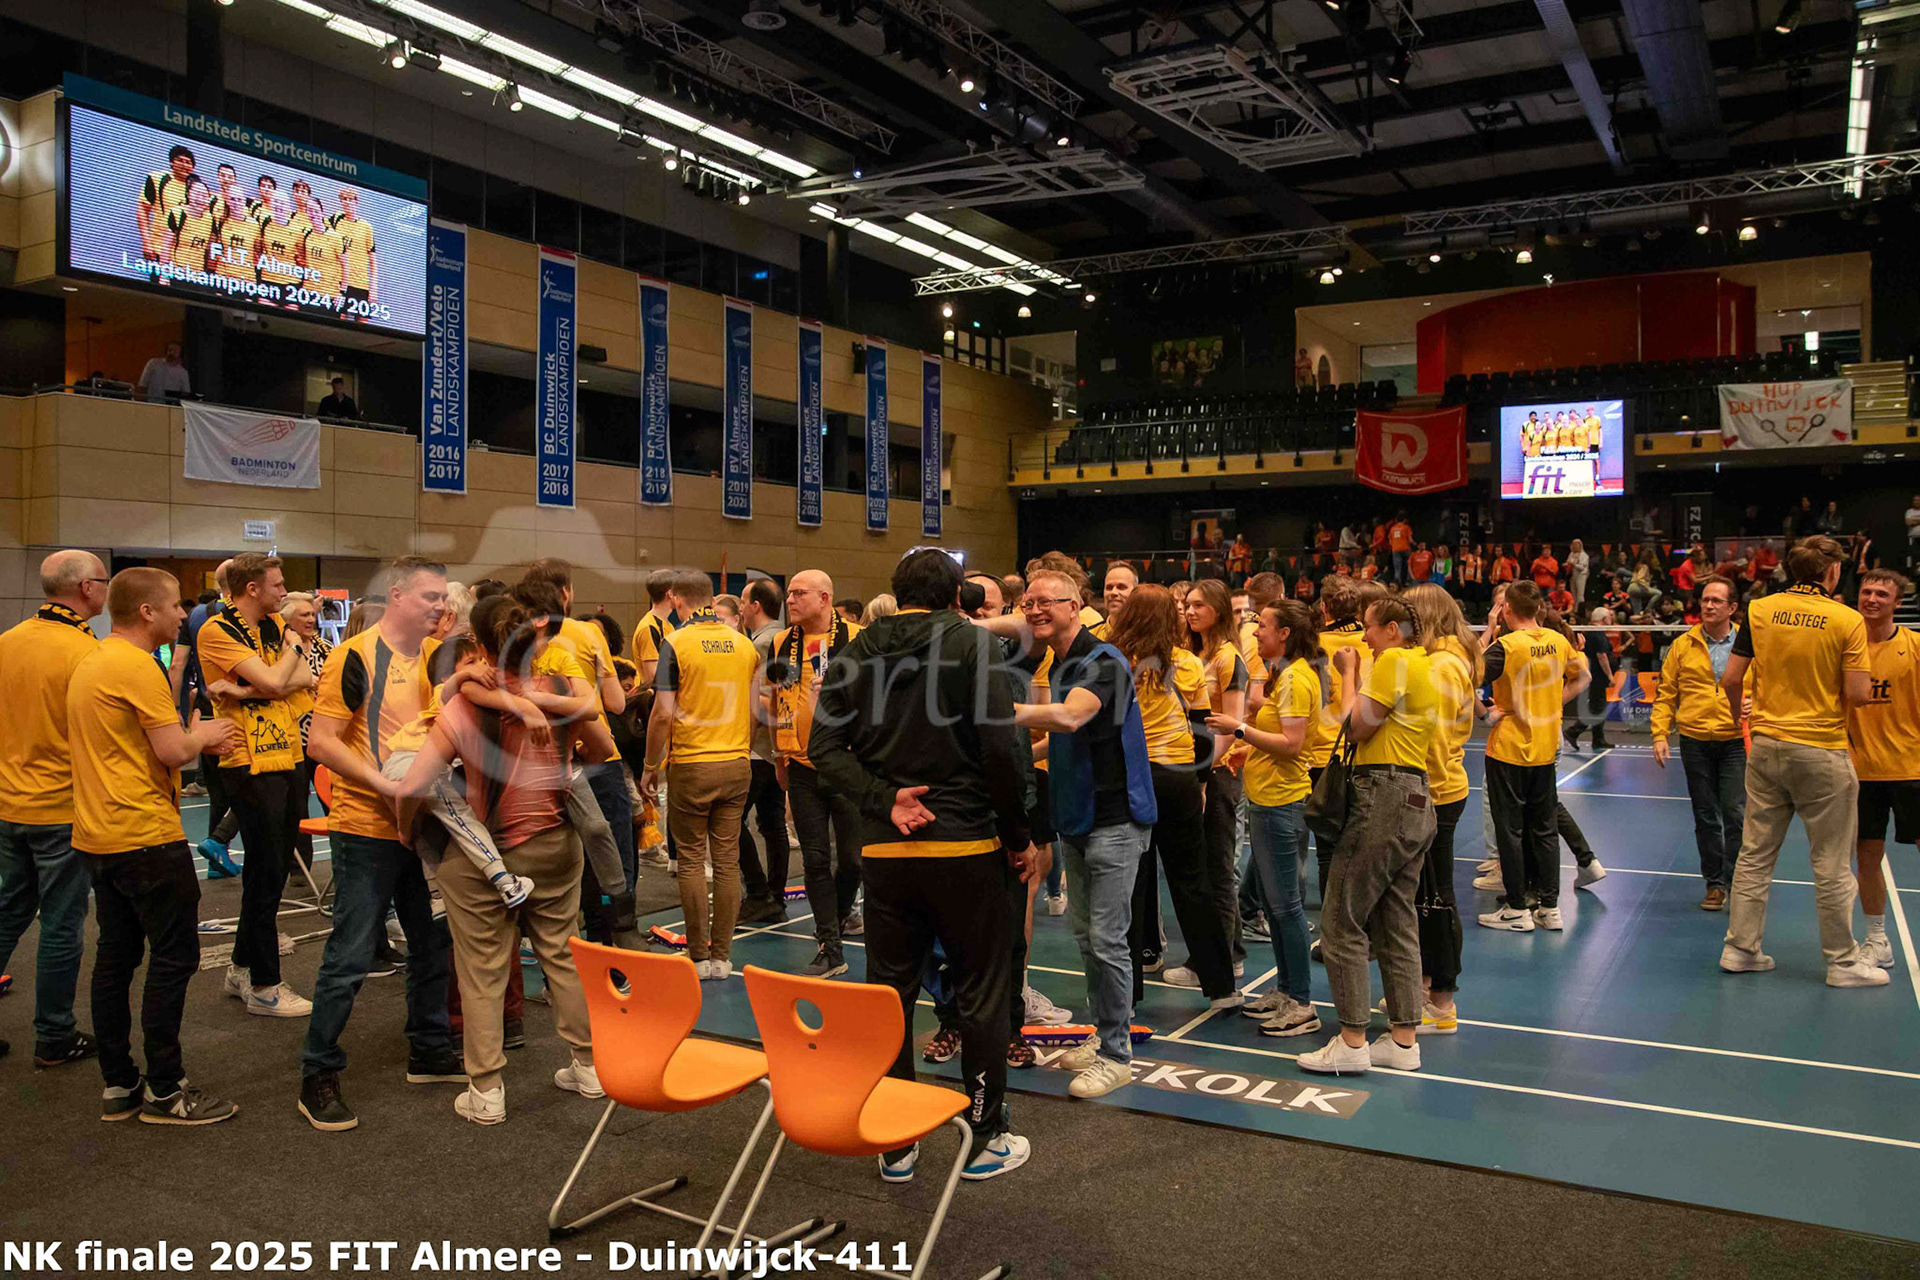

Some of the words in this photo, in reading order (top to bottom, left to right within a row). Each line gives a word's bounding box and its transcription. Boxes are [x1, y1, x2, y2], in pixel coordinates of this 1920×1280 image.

[163, 104, 251, 145] Landstede
[254, 132, 358, 176] Sportcentrum
[256, 255, 322, 283] Almere
[121, 250, 281, 301] Landskampioen
[285, 285, 333, 309] 2024
[346, 298, 391, 321] 2025
[430, 284, 443, 399] Zundert/Velo
[447, 286, 461, 437] LANDSKAMPIOEN
[543, 351, 556, 429] Duinwijck
[558, 317, 570, 457] LANDSKAMPIOEN
[1763, 381, 1803, 399] HUP
[655, 344, 666, 460] LANDSKAMPIOEN
[430, 407, 443, 436] Van
[741, 364, 749, 475] LANDSKAMPIOEN
[812, 381, 820, 485] LANDSKAMPIOEN
[428, 443, 461, 461] 2016
[544, 432, 556, 455] BC
[231, 456, 296, 471] BADMINTON
[238, 467, 290, 479] NEDERLAND
[428, 463, 461, 480] 2017
[542, 462, 570, 479] 2017
[729, 454, 739, 474] BV
[804, 465, 812, 484] BC
[542, 480, 569, 496] 2018
[727, 480, 749, 493] 2019
[1771, 610, 1829, 631] HOLSTEGE
[701, 640, 735, 654] SCHRIJER
[1529, 643, 1558, 657] DYLAN
[254, 742, 291, 754] ALMERE
